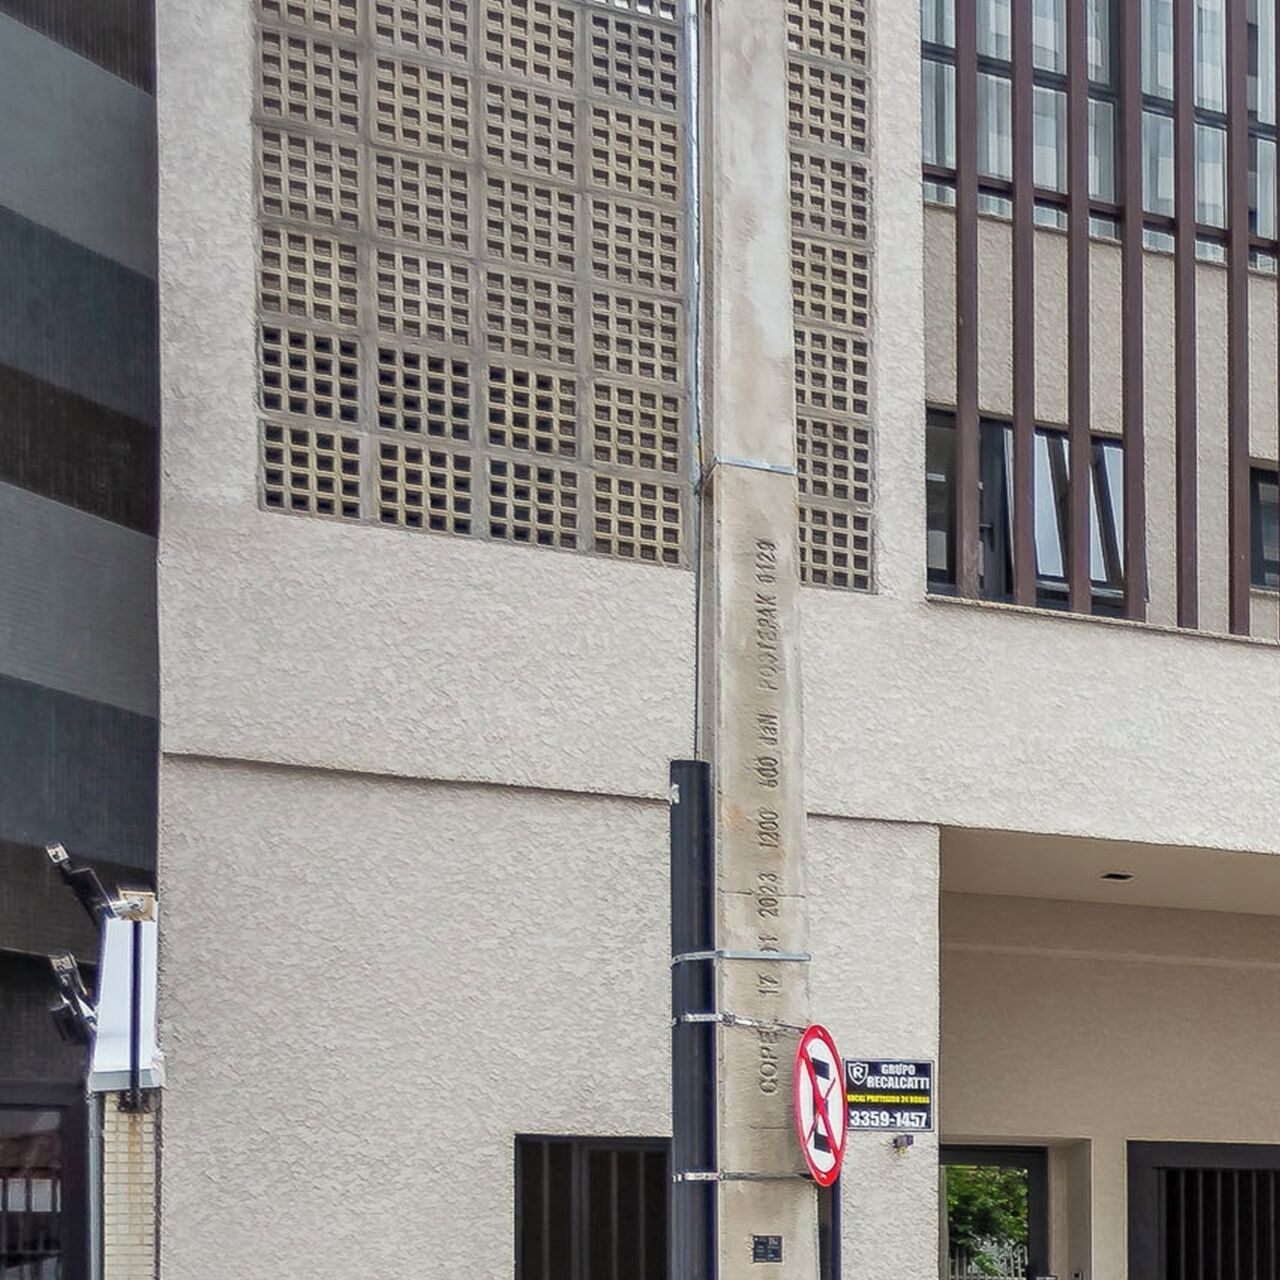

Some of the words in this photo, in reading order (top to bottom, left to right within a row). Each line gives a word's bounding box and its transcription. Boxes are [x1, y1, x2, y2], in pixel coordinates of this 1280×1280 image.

[757, 811, 779, 849] 1200
[757, 872, 779, 918] 2023
[757, 1018, 778, 1093] COPE
[852, 1065, 864, 1079] R
[881, 1063, 916, 1076] GRUPO
[866, 1076, 930, 1090] RECALCATTI
[850, 1110, 928, 1128] 3359-1457
